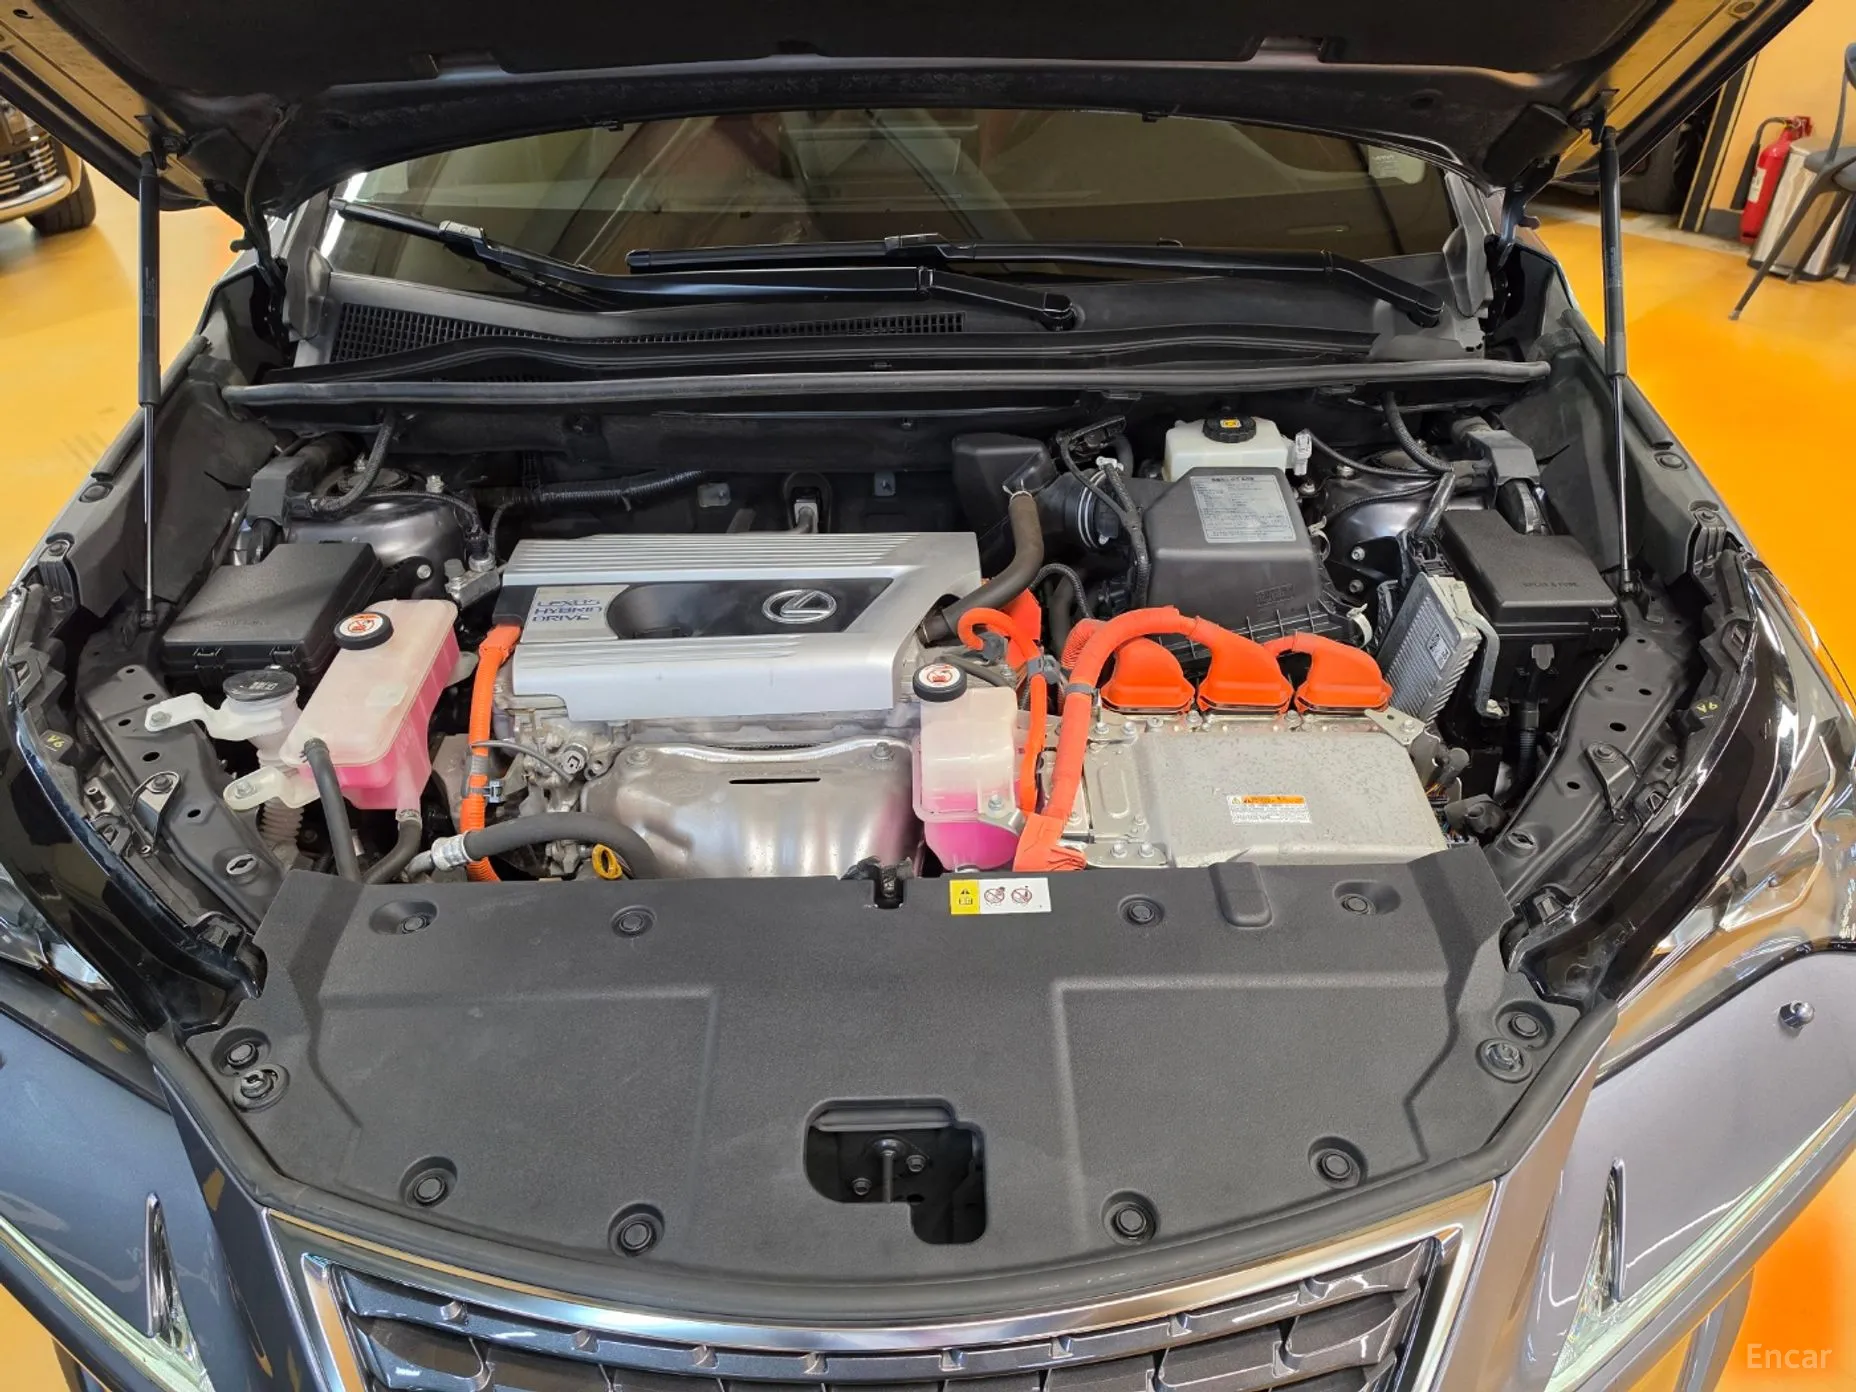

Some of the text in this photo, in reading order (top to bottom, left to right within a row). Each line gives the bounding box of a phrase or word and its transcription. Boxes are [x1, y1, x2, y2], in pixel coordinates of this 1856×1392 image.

[537, 599, 601, 607] LEXUS
[534, 606, 603, 615] HYBRID
[532, 614, 590, 622] DRIVE
